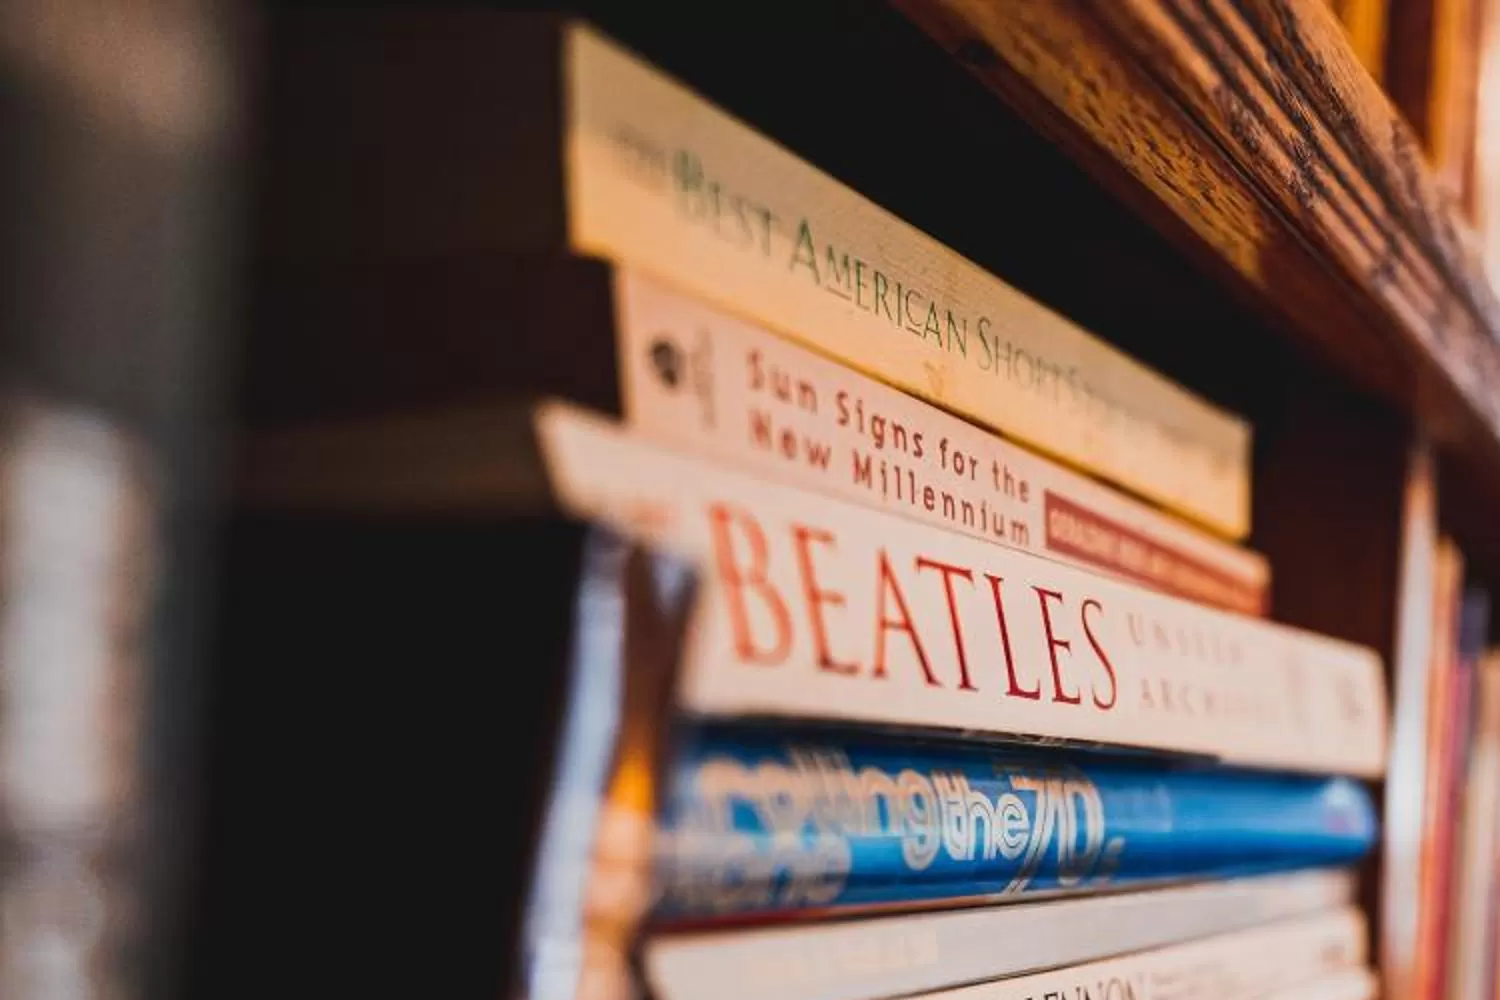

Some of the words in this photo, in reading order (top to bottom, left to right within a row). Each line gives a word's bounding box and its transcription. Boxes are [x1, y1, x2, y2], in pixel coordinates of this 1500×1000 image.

[673, 149, 782, 257] BEST
[788, 215, 968, 360] AMERICAN
[746, 347, 819, 416] Sun
[836, 390, 925, 459] Signs
[939, 436, 980, 481] for
[992, 463, 1031, 503] the
[747, 407, 832, 472] New
[853, 446, 1031, 546] Millennium
[704, 500, 1118, 711] BEATLES
